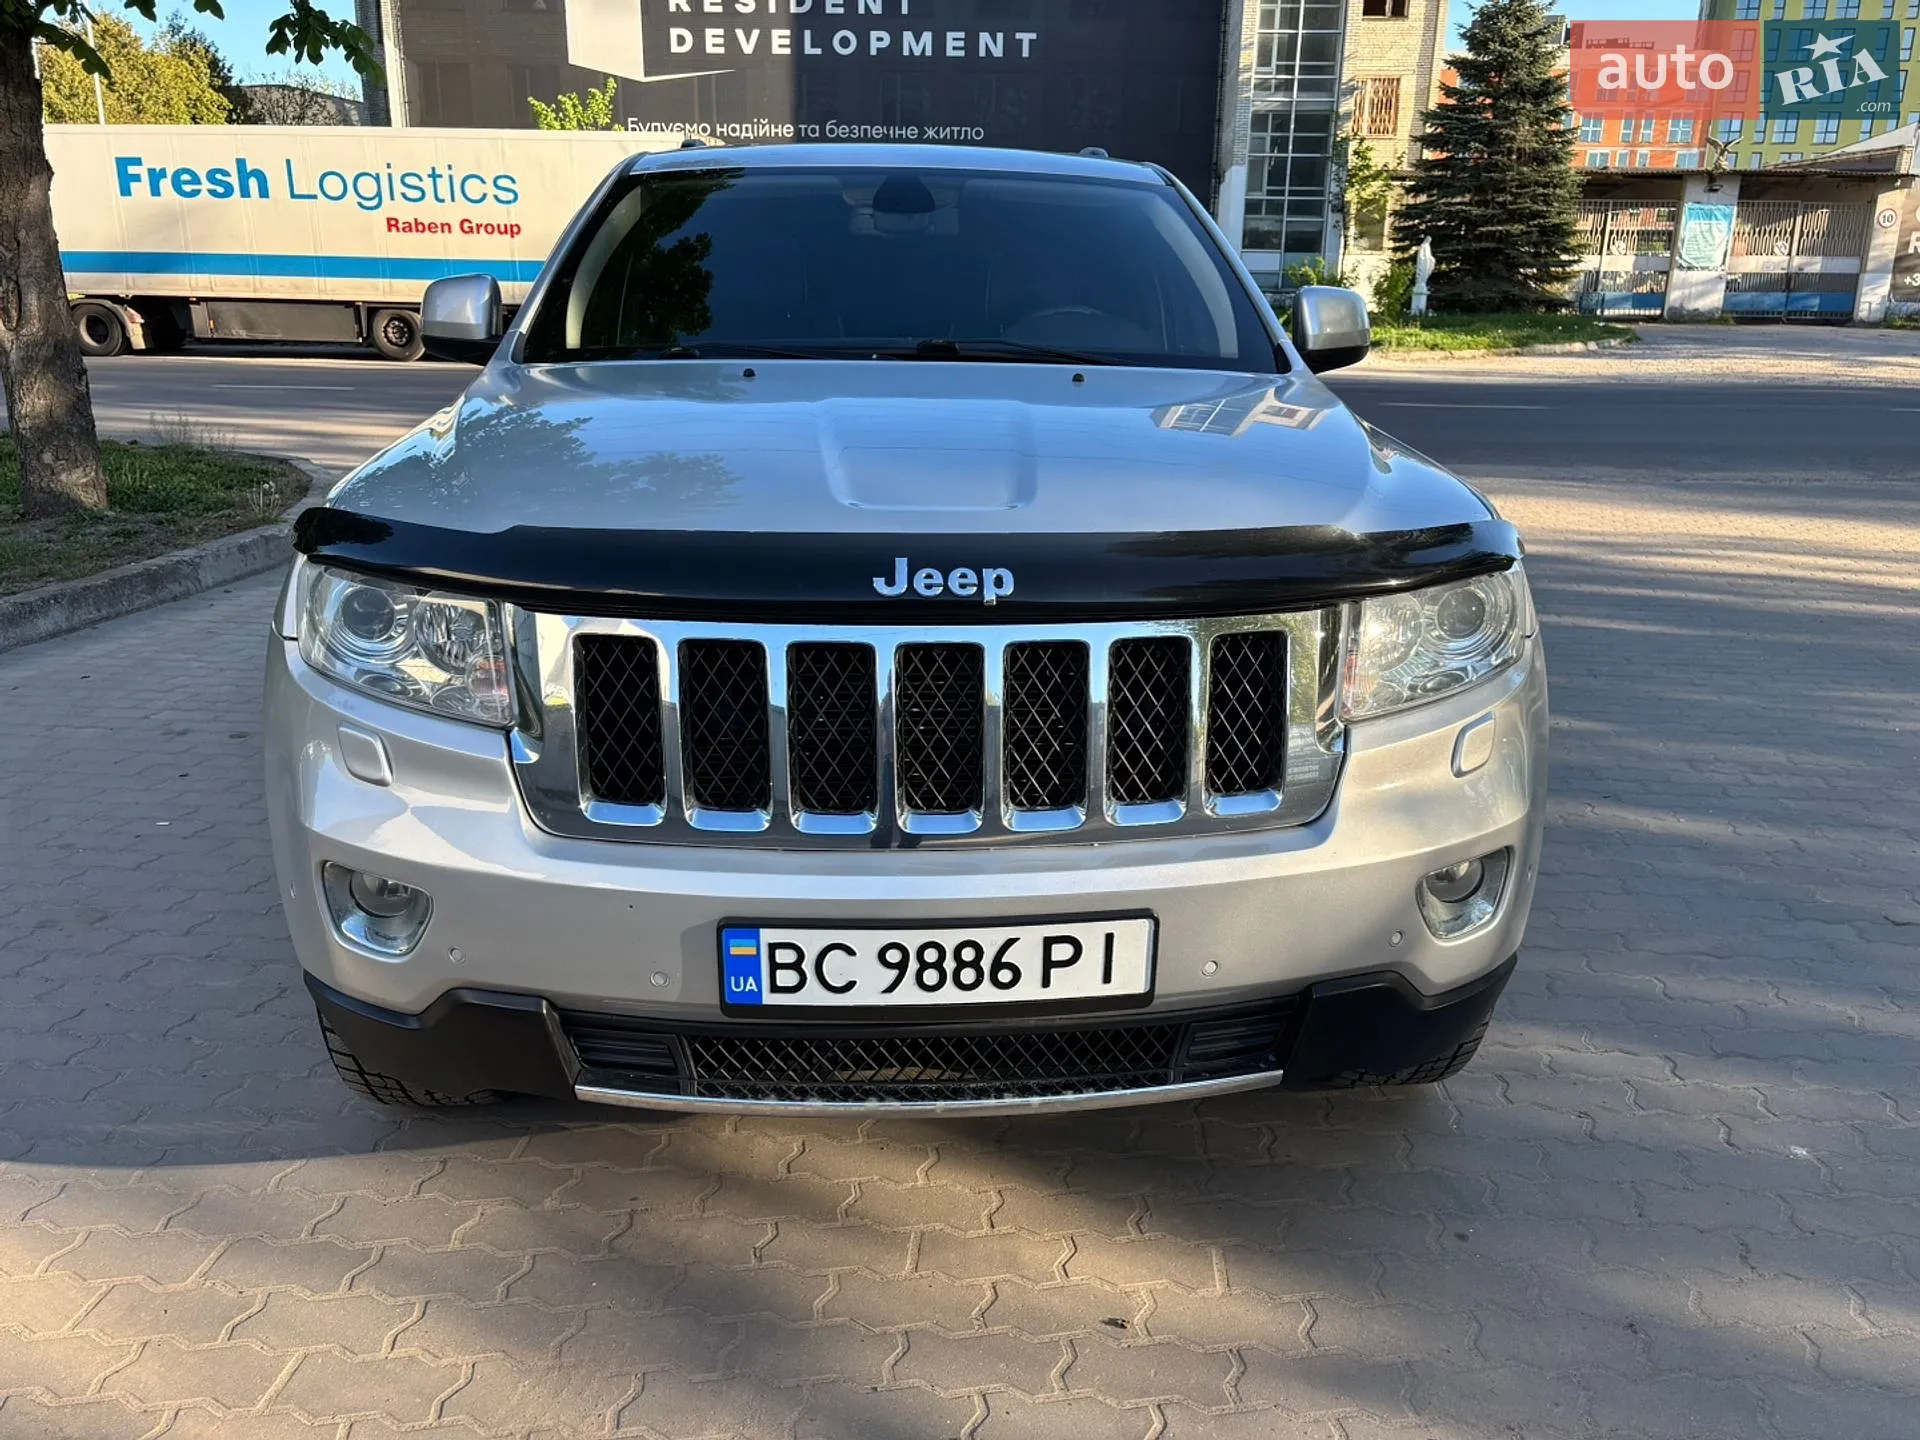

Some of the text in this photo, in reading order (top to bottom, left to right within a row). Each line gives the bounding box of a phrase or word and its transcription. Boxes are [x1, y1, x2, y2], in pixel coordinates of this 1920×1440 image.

[669, 27, 1037, 58] DEVELOPMENT
[715, 118, 795, 140] надійне
[799, 124, 821, 138] та
[825, 120, 919, 139] безпечне
[922, 126, 985, 141] житло
[114, 156, 520, 212] Fresh Logistics
[386, 216, 522, 239] Raben Group
[1882, 213, 1894, 224] 10
[872, 557, 1015, 606] Jeep
[768, 941, 858, 995] BC
[878, 937, 1023, 994] 9886
[731, 976, 758, 993] UA
